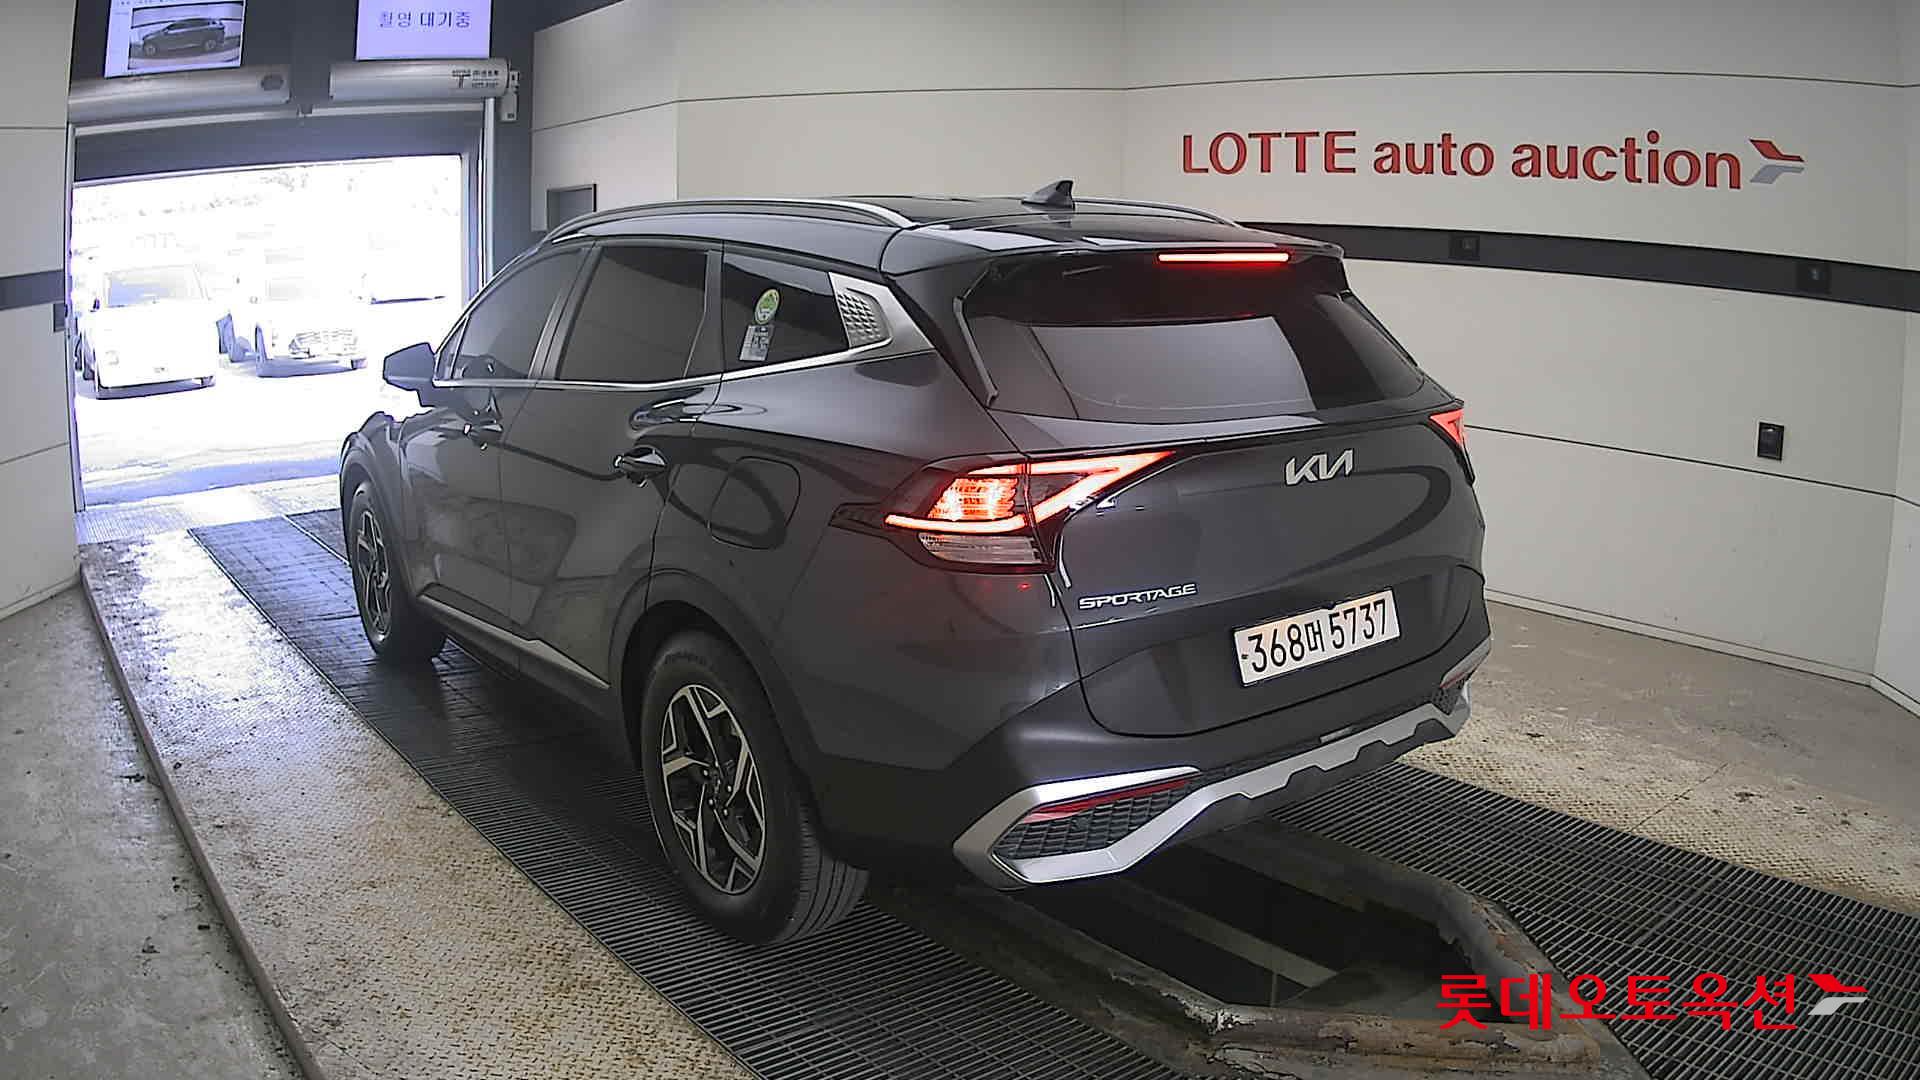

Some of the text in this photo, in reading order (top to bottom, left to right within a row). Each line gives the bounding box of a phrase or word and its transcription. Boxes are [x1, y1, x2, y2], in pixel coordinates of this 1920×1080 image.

[420, 11, 470, 28] 대기중
[1182, 130, 1742, 190] LOTTE auto auction
[1079, 583, 1197, 609] SPORTAGE
[1248, 599, 1386, 673] 368머 5737
